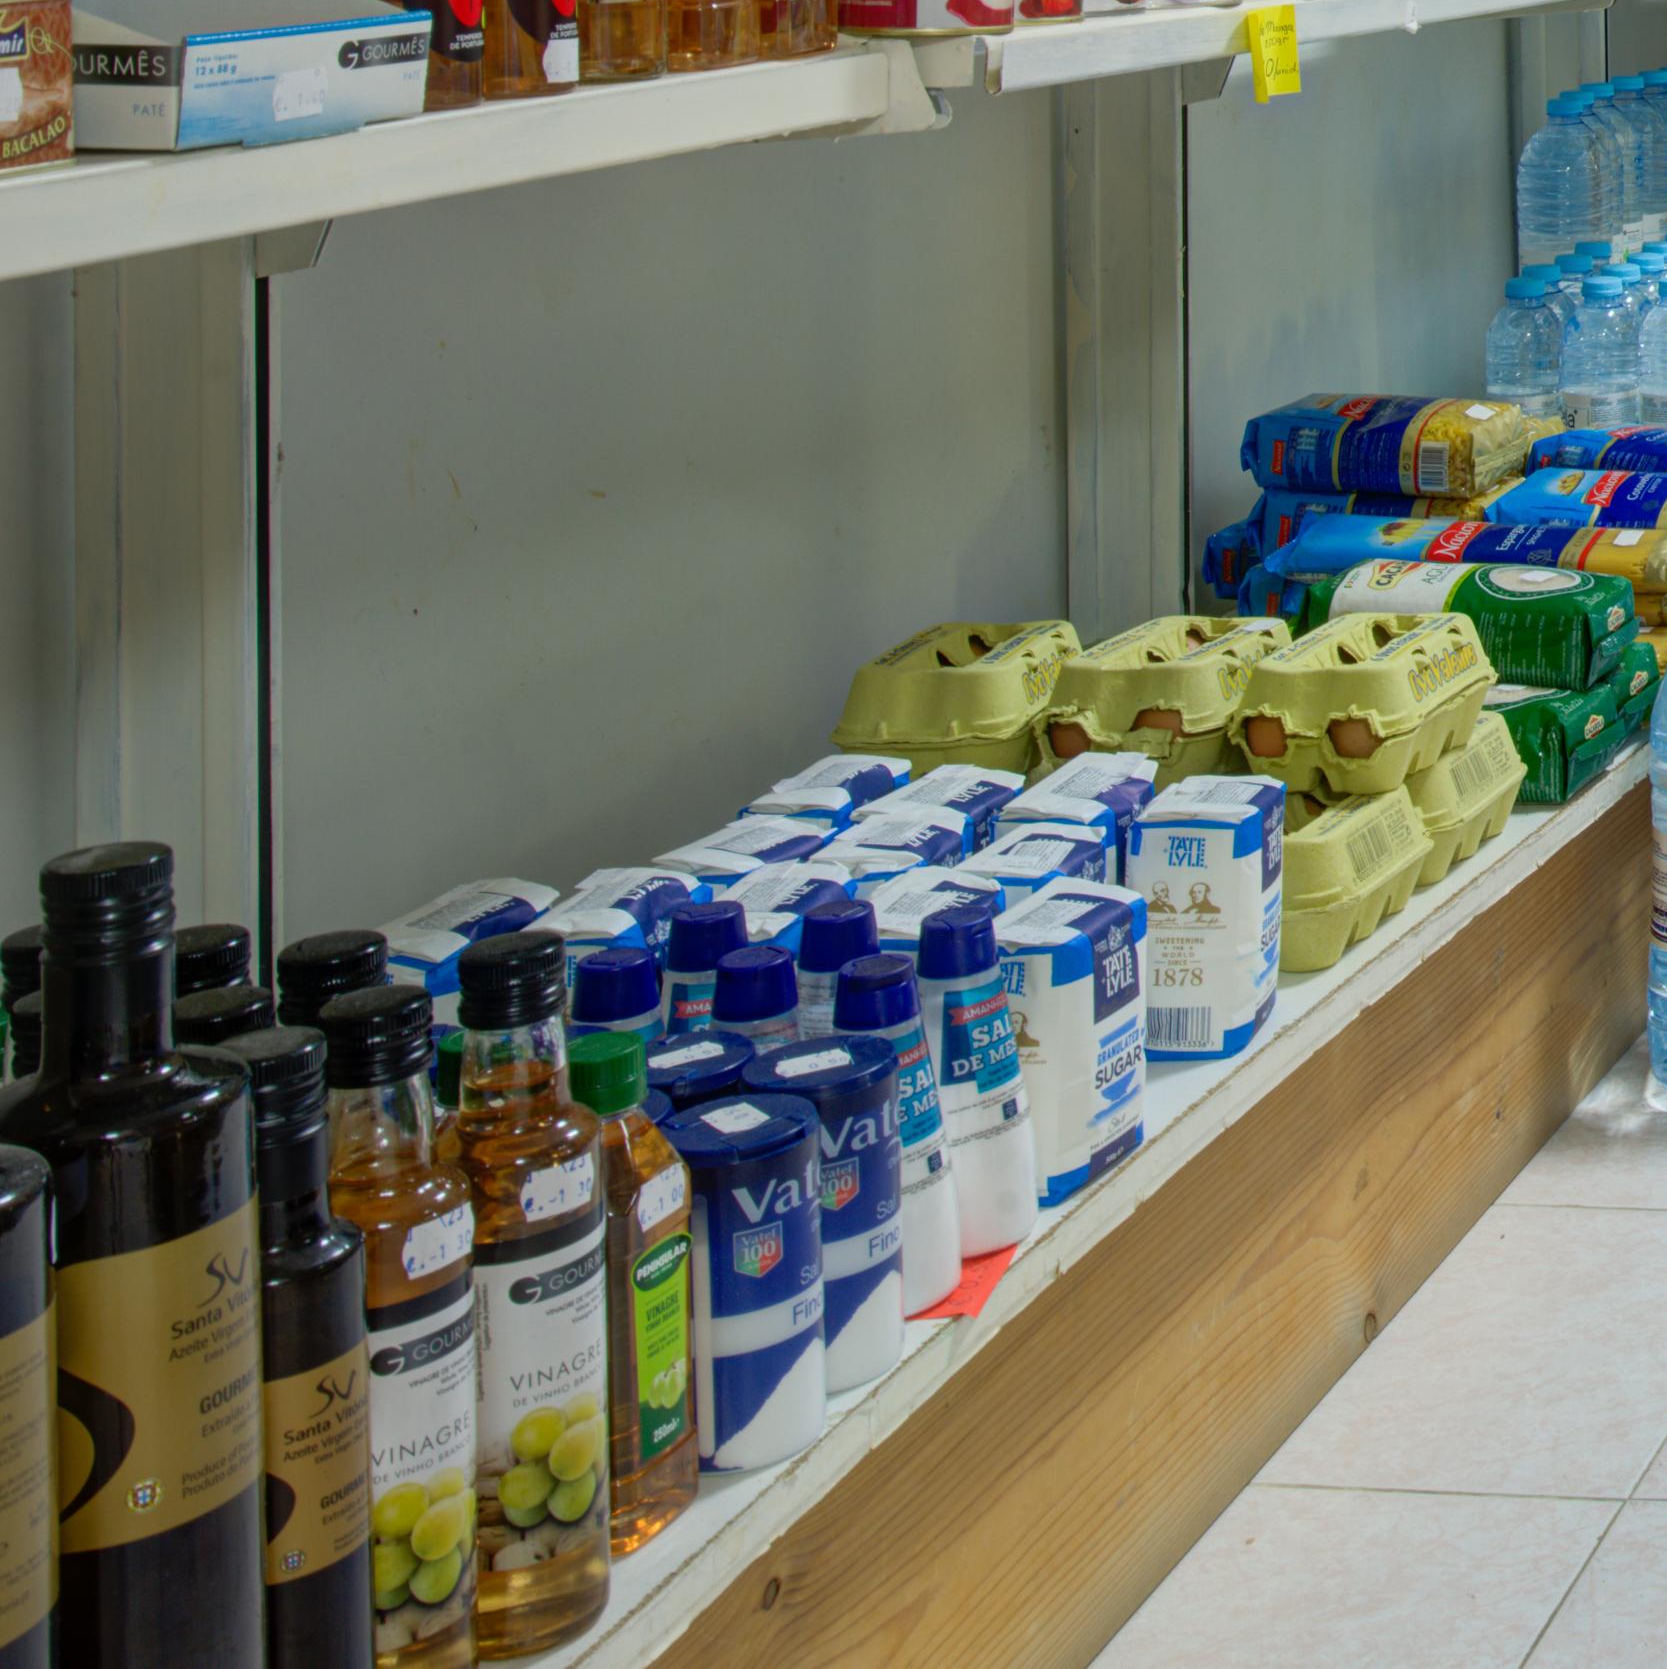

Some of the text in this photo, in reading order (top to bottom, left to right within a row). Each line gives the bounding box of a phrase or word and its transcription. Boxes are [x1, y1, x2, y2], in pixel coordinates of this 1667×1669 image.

[362, 39, 425, 61] GOURMÊS
[1155, 936, 1206, 945] SWEETENING
[1101, 945, 1133, 973] TATE
[1160, 951, 1197, 959] WORLD
[1105, 965, 1135, 999] LYLE
[1151, 967, 1204, 988] 1878
[1097, 1031, 1142, 1068] GRANULATED
[951, 1054, 984, 1078] DE
[1094, 1044, 1143, 1090] SUGAR
[741, 1225, 777, 1246] Vatel
[636, 1240, 689, 1282] PENINSULAR
[741, 1240, 777, 1265] 100
[171, 1304, 222, 1341] Santa
[168, 1336, 208, 1363] Azeite
[510, 1338, 601, 1392] VINAGRE
[512, 1383, 571, 1409] DE VINHO
[283, 1419, 331, 1446] Santa
[373, 1409, 471, 1468] VINAGRE
[181, 1454, 225, 1486] Produce
